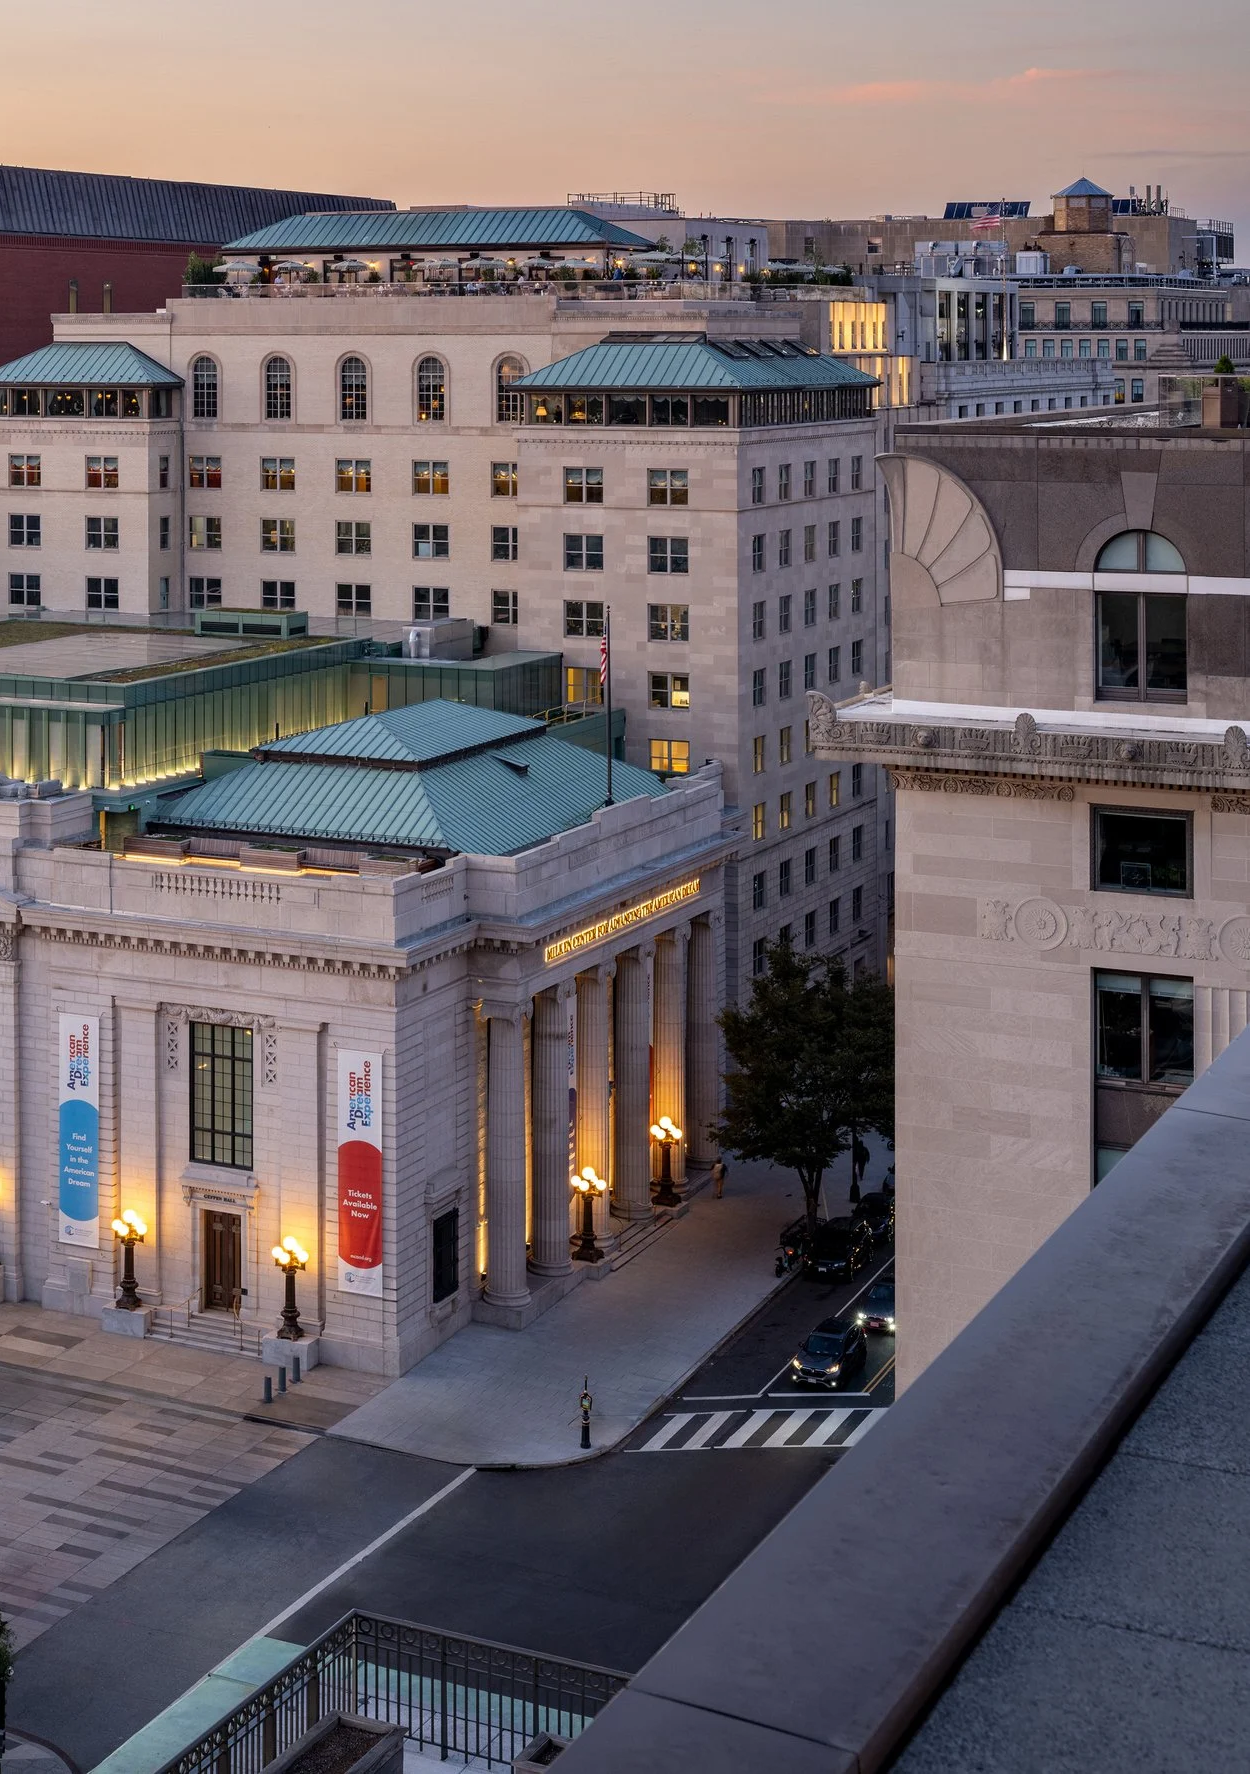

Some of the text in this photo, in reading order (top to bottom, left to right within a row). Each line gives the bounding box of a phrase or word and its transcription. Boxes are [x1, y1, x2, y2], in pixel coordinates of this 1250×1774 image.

[545, 937, 571, 962] MILKEN
[572, 926, 596, 950] CENTER
[73, 1040, 82, 1080] Dream
[80, 1023, 91, 1087] Experience
[66, 1034, 76, 1090] American
[354, 1077, 363, 1119] Dream
[361, 1060, 373, 1128] Experience
[346, 1071, 356, 1131] American
[72, 1132, 86, 1141] Find
[66, 1143, 93, 1153] Yourself
[70, 1155, 89, 1164] in the
[64, 1166, 95, 1177] American
[68, 1177, 91, 1187] Dream
[348, 1189, 372, 1199] Tickets
[343, 1199, 377, 1210] Available
[351, 1210, 369, 1219] Now
